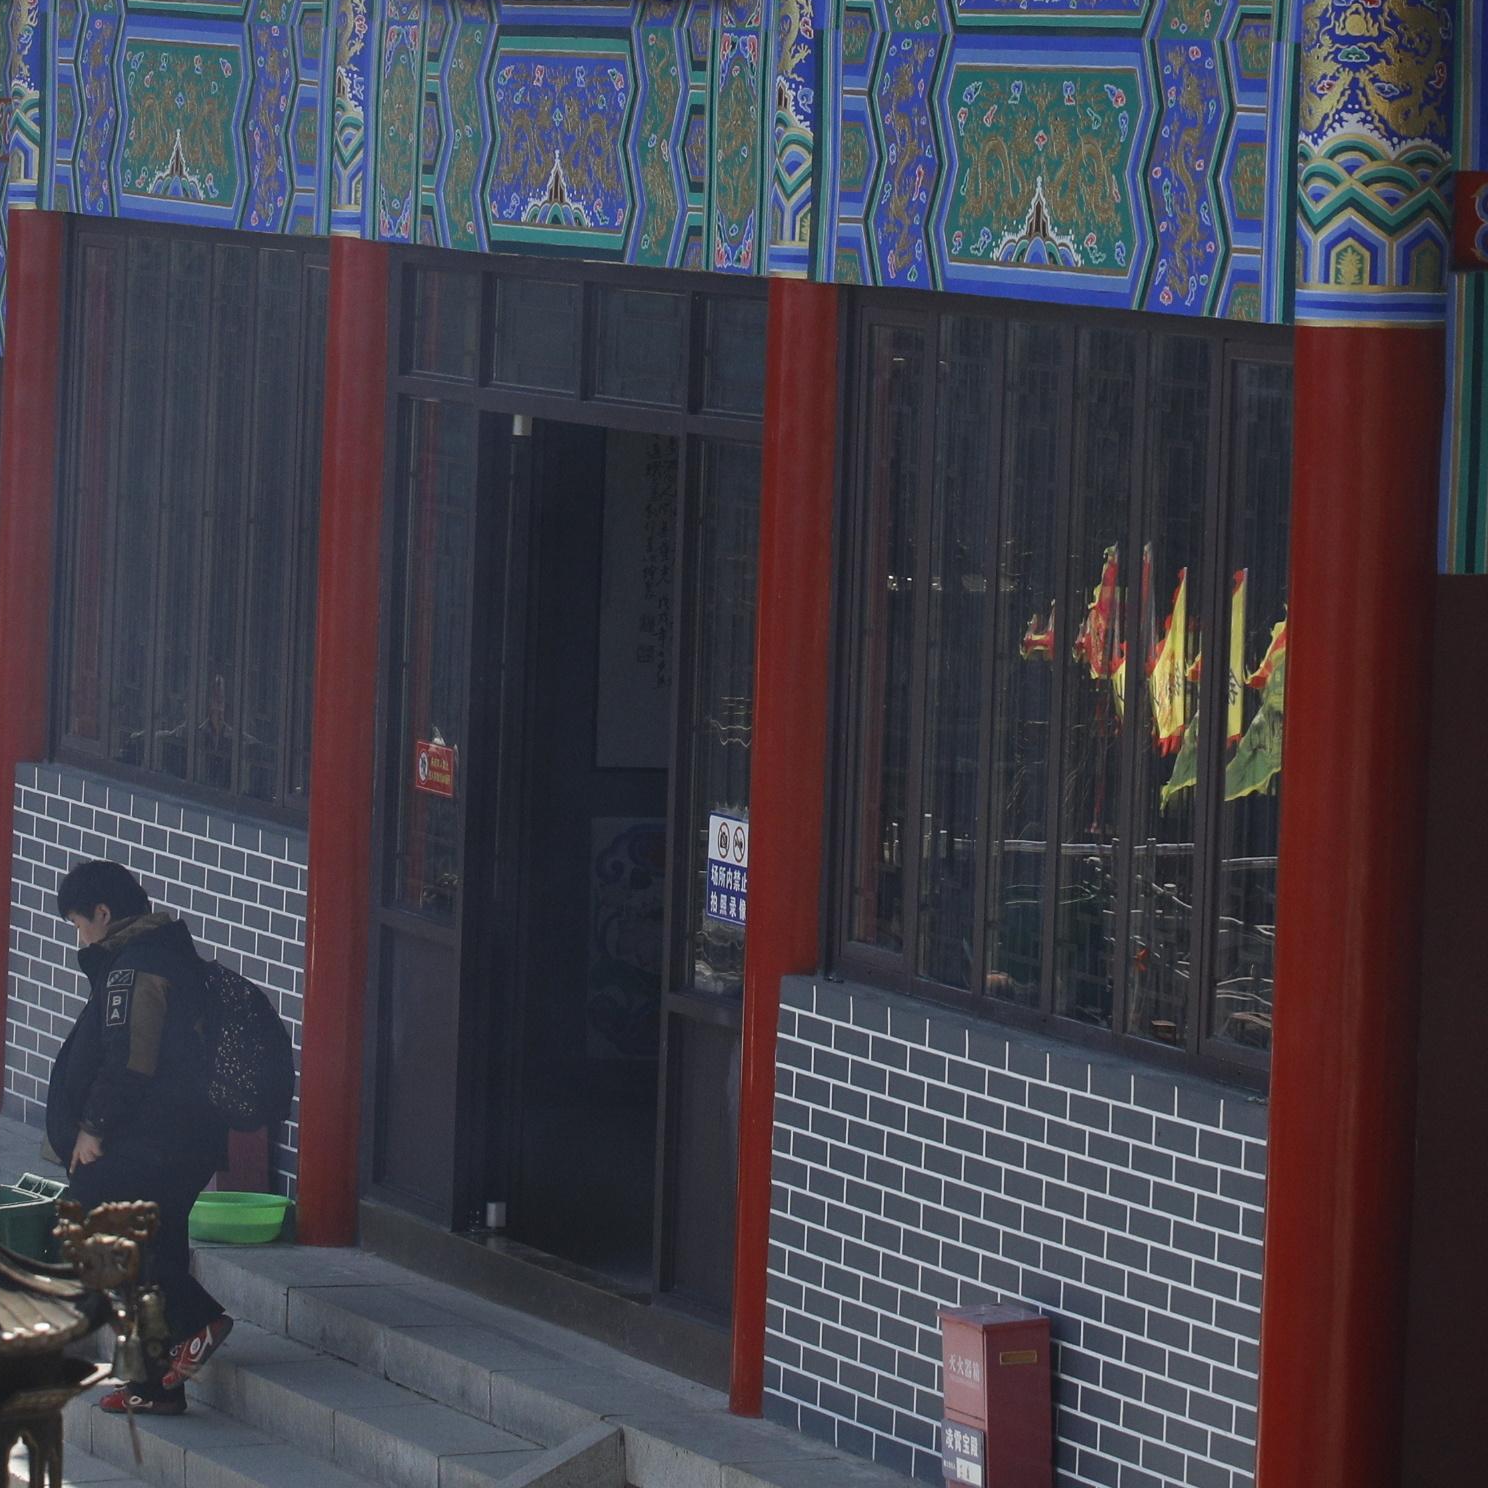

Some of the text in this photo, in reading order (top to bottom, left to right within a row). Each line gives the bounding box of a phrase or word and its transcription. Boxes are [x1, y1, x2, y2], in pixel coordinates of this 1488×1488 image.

[711, 863, 747, 893] 场所内禁止
[710, 890, 747, 921] 拍照录像
[948, 1352, 981, 1384] 灭火器箱
